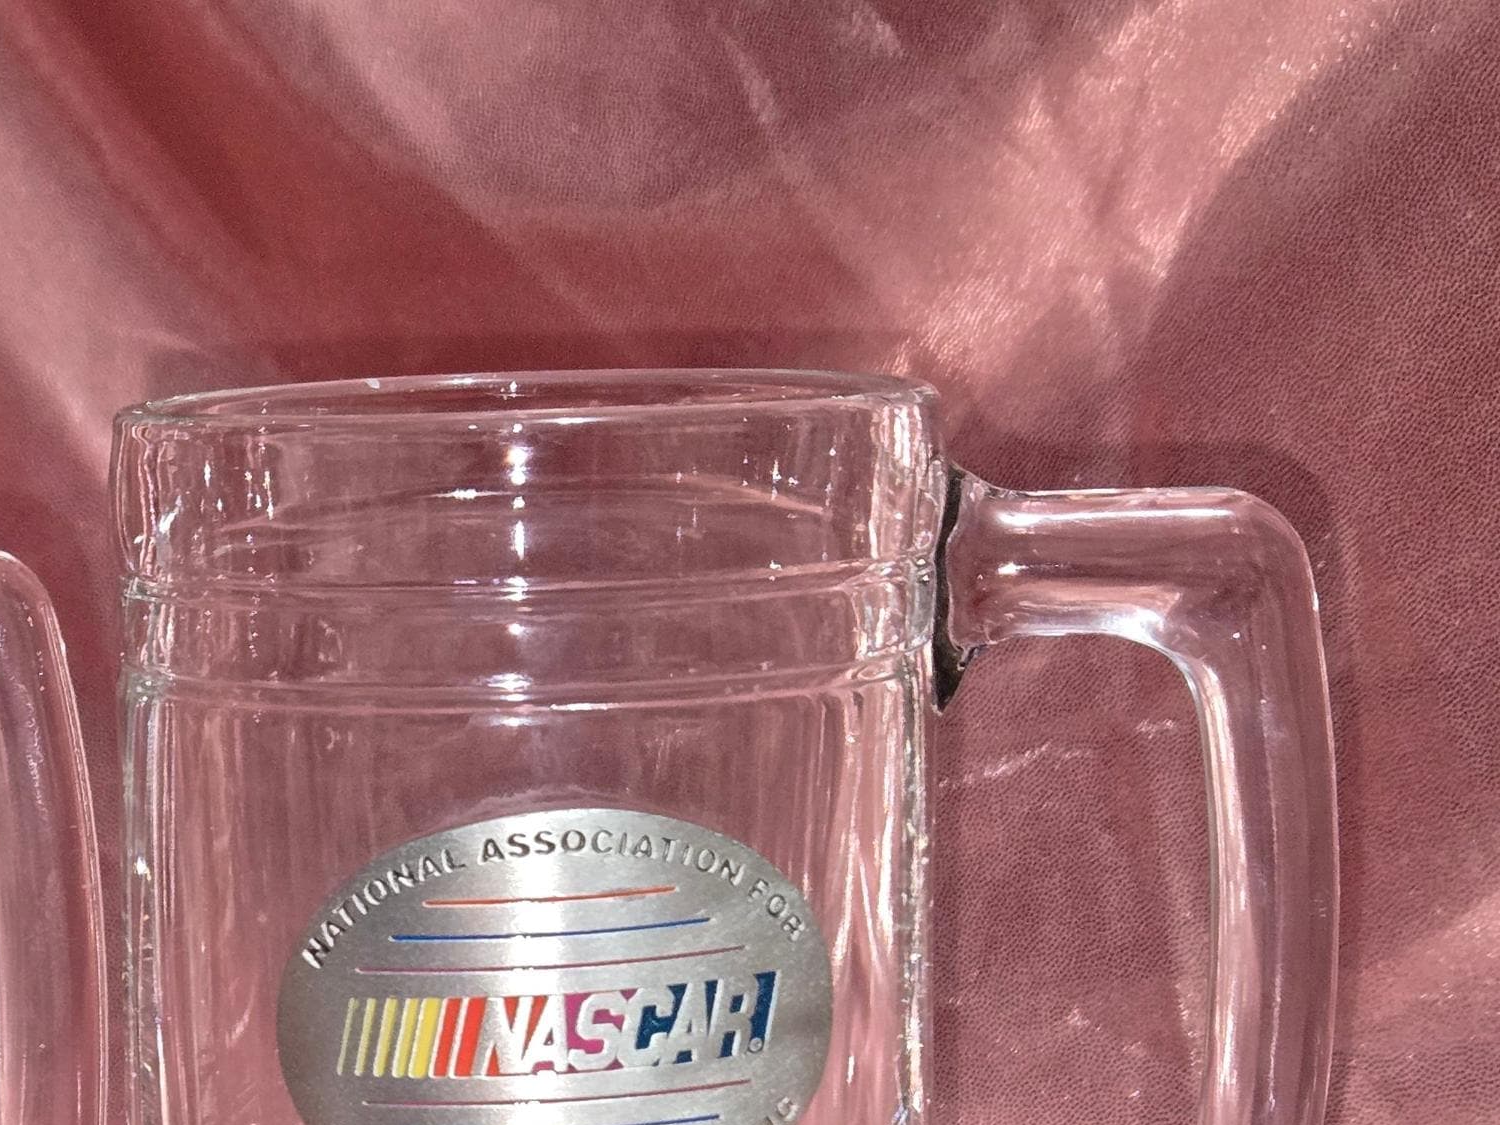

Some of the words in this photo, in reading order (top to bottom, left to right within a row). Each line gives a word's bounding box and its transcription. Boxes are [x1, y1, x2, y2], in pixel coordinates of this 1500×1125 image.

[300, 849, 467, 970] NATIONAL
[479, 829, 744, 887] ASSOCIATION
[749, 879, 807, 943] FOR
[477, 977, 754, 1077] NASCAR
